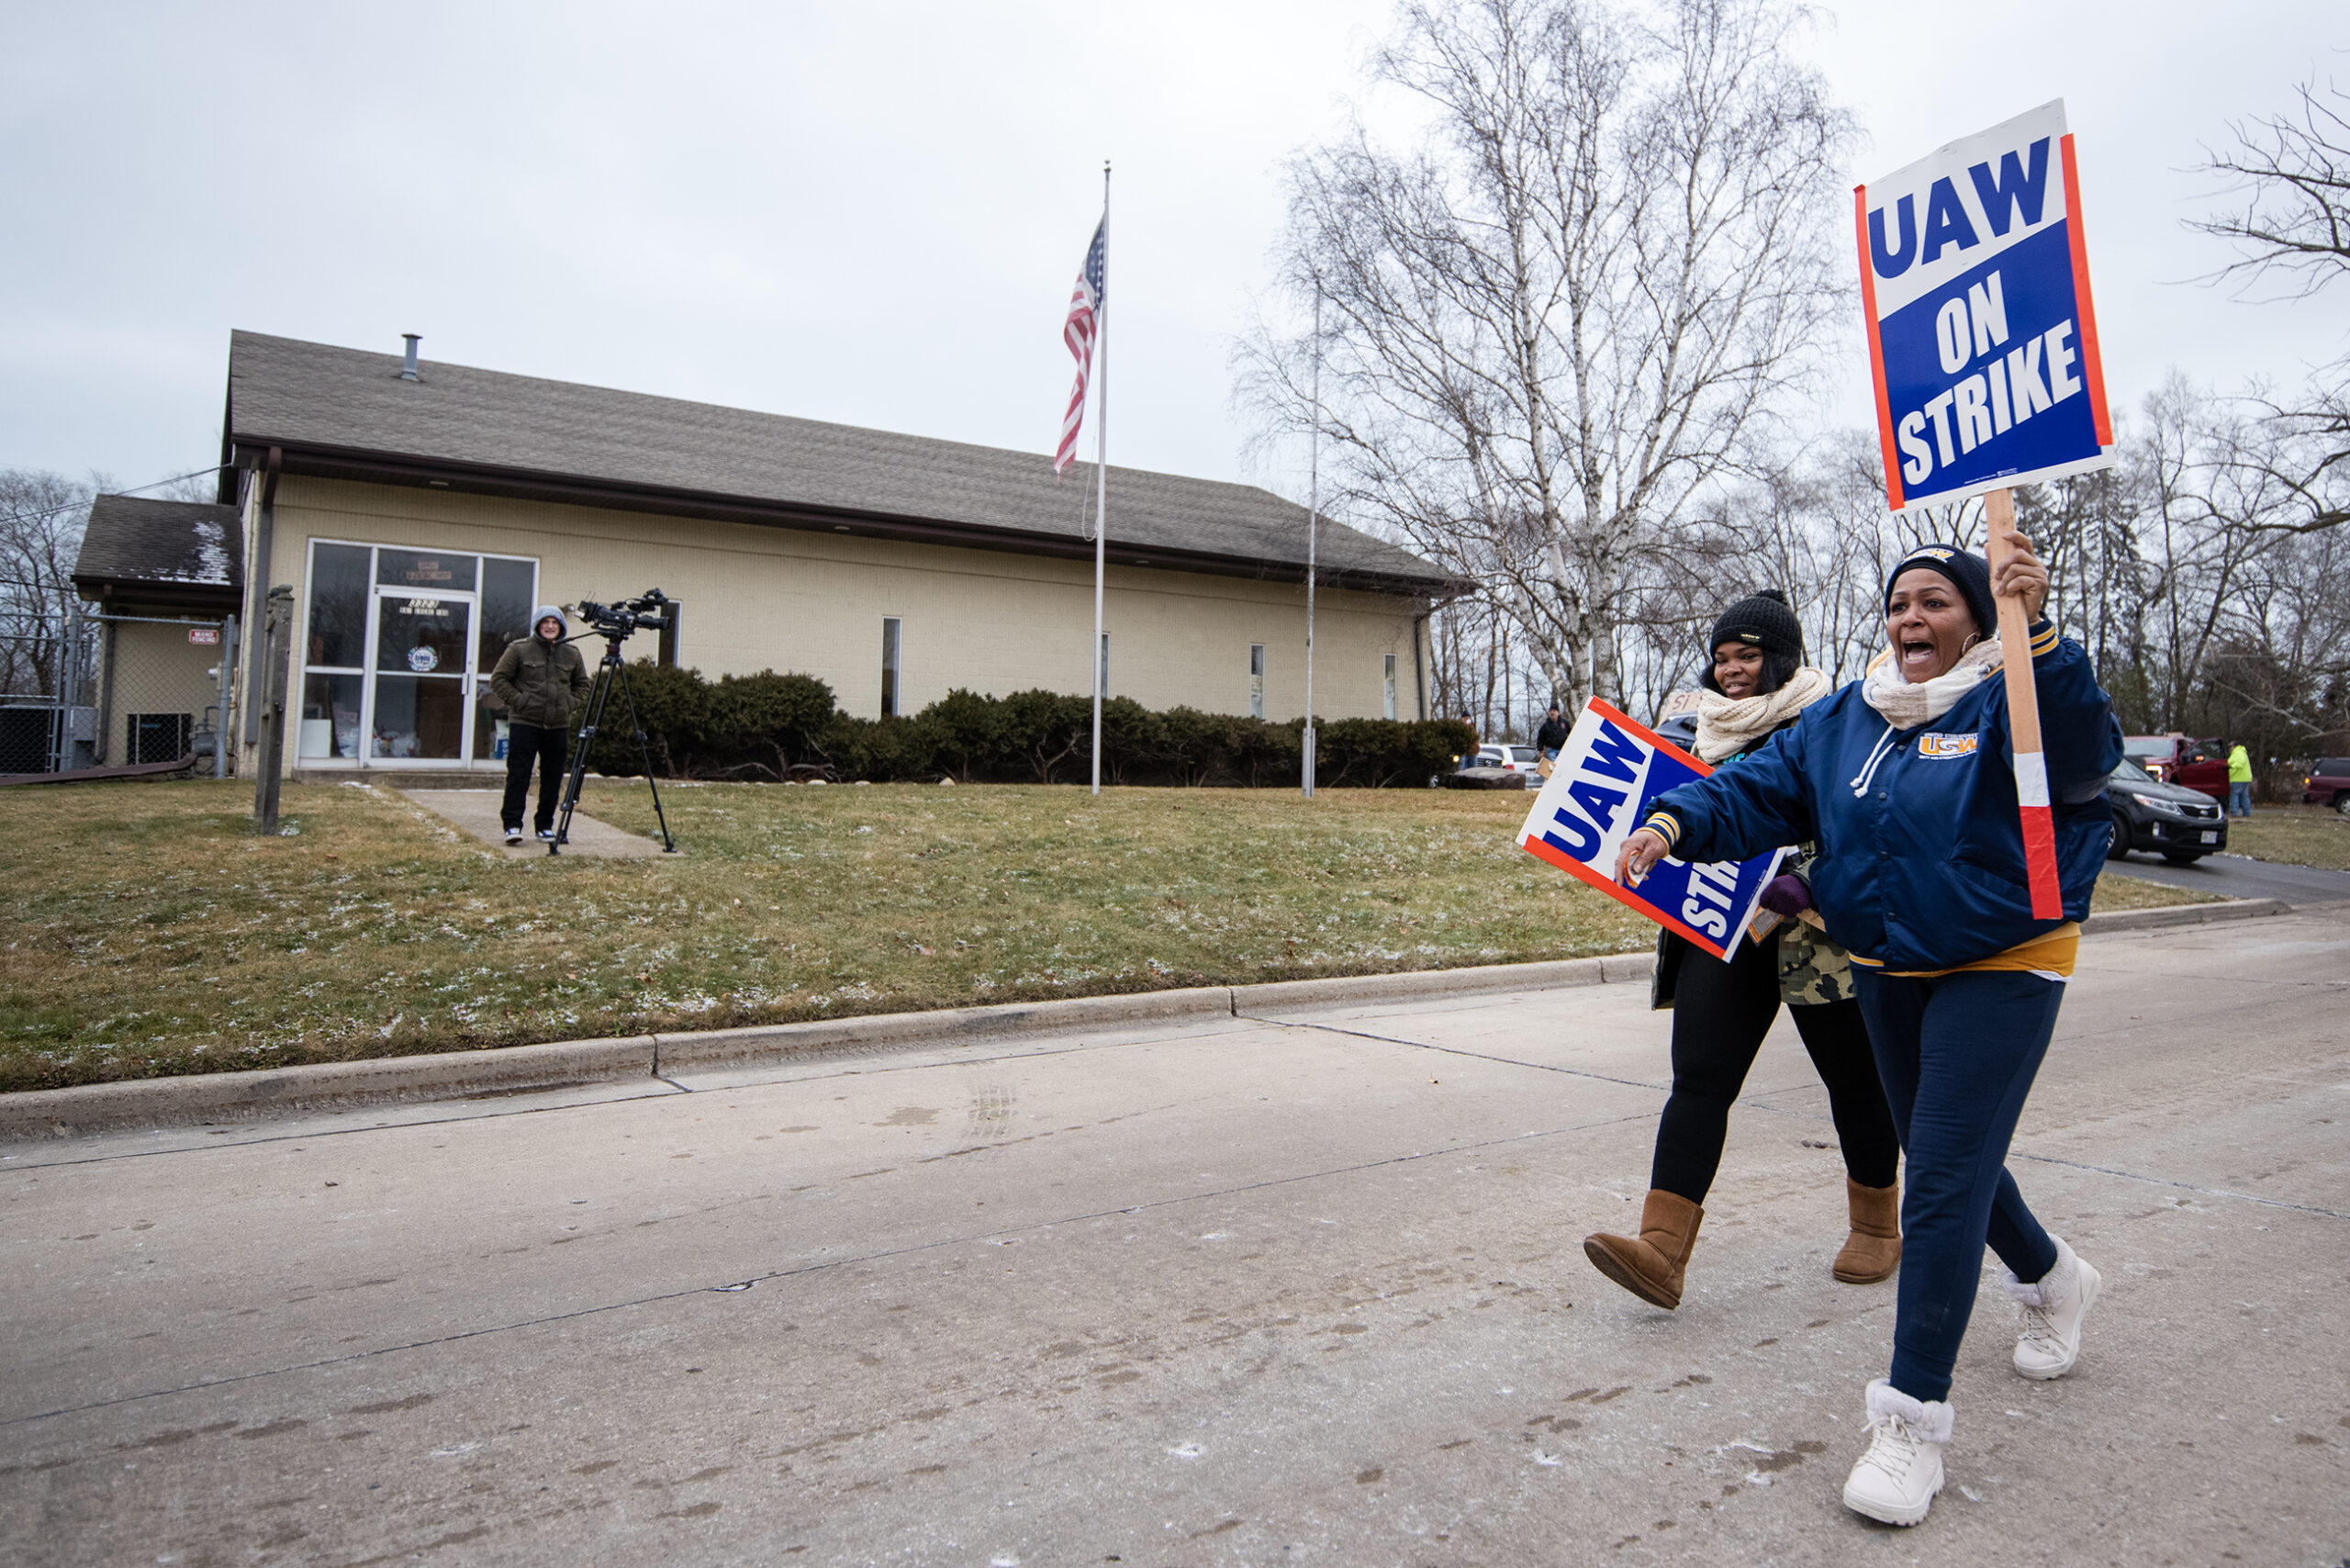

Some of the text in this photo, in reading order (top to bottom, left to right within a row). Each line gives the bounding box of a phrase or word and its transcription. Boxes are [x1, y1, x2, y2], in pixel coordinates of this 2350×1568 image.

[1868, 136, 2051, 278] UAW
[1936, 270, 2009, 375] ON
[1897, 319, 2081, 486] STRIKE
[1541, 719, 1647, 863] UAW
[1682, 860, 1740, 938] STR
